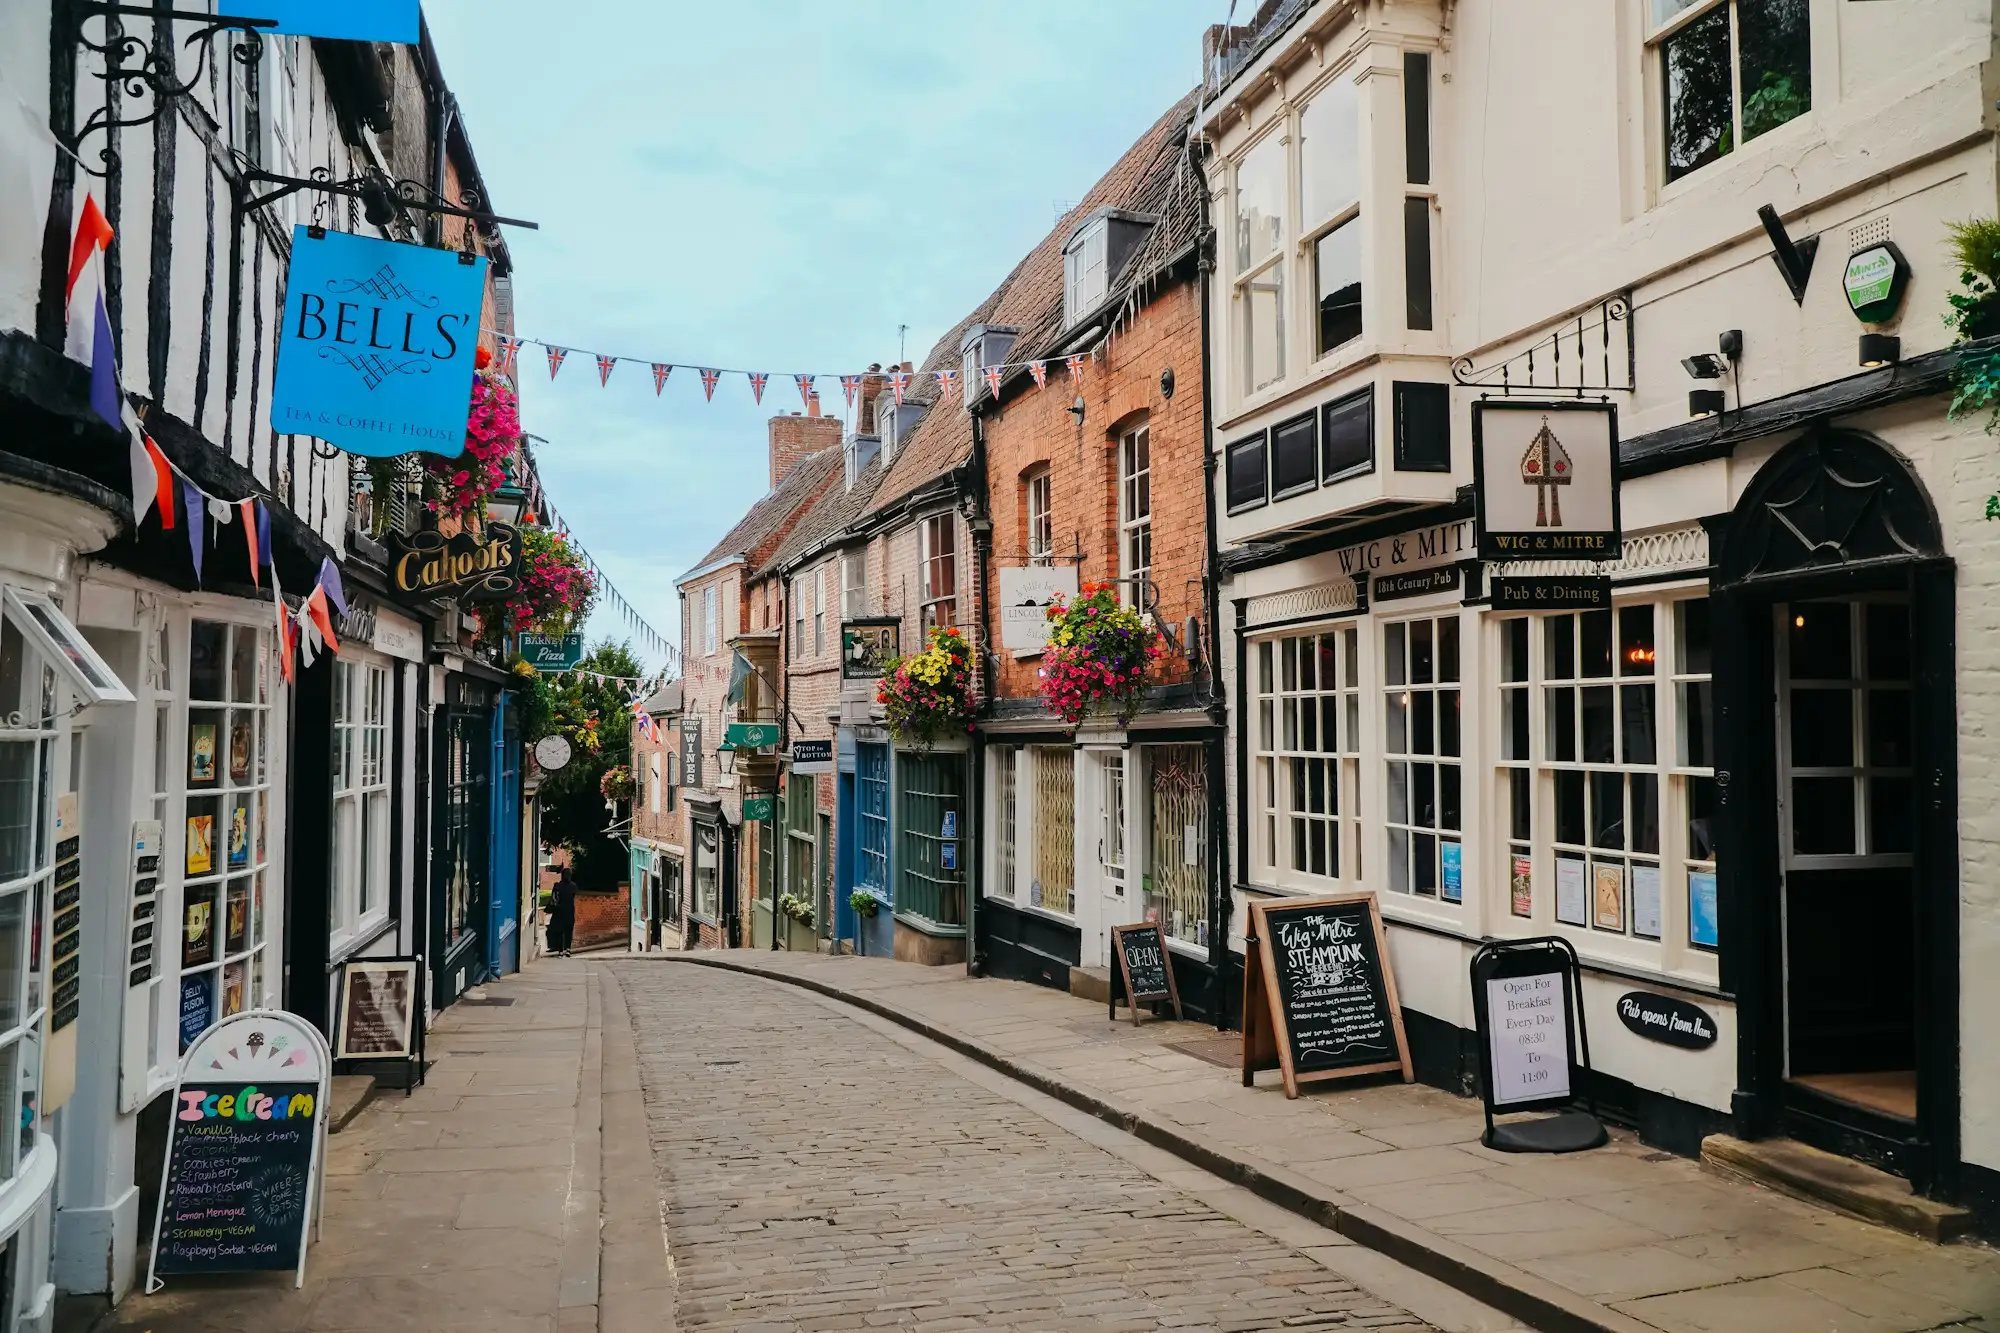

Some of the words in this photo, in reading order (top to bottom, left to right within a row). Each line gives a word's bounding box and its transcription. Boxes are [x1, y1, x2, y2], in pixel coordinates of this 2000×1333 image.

[1849, 262, 1877, 277] MINT
[296, 293, 470, 360] BELLS'
[318, 411, 331, 424] &
[1496, 536, 1529, 549] WIG
[1535, 536, 1547, 549] &
[1553, 536, 1605, 549] MITRE
[1338, 541, 1381, 575] WIG
[1391, 538, 1407, 564] &
[396, 538, 513, 592] Cahoots
[1377, 582, 1395, 594] 18th
[1397, 577, 1432, 590] Century
[1433, 570, 1452, 585] Pub
[1503, 585, 1529, 600] Pub
[1534, 586, 1547, 599] &
[1552, 585, 1600, 602] Dining
[536, 647, 565, 661] Pizza
[684, 733, 698, 784] WINES
[1302, 915, 1325, 926] THE
[1278, 923, 1311, 949] Wig
[1316, 918, 1360, 944] Mitre
[1126, 947, 1158, 967] OPEN
[1288, 943, 1366, 968] STEAMPUNK
[1304, 962, 1344, 974] WEEKEND
[185, 984, 202, 999] BELLY
[1503, 981, 1532, 995] Open
[1534, 978, 1552, 990] For
[184, 996, 205, 1012] FUSION
[1507, 996, 1552, 1011] Breakfast
[1506, 1018, 1533, 1029] Every
[1536, 1014, 1555, 1026] Day
[1621, 998, 1641, 1019] Pub
[1641, 1010, 1668, 1026] opens
[1669, 1011, 1694, 1034] from
[1518, 1032, 1546, 1045] 08:30
[1525, 1052, 1541, 1064] To
[1522, 1069, 1548, 1084] 11:00
[188, 1124, 233, 1136] Vanilla
[180, 1167, 239, 1183] Strawberry
[261, 1177, 292, 1198] WAFER
[271, 1188, 292, 1203] CONE
[176, 1211, 205, 1221] Lemon
[206, 1207, 247, 1221] Meringue
[172, 1242, 217, 1261] Raspberry
